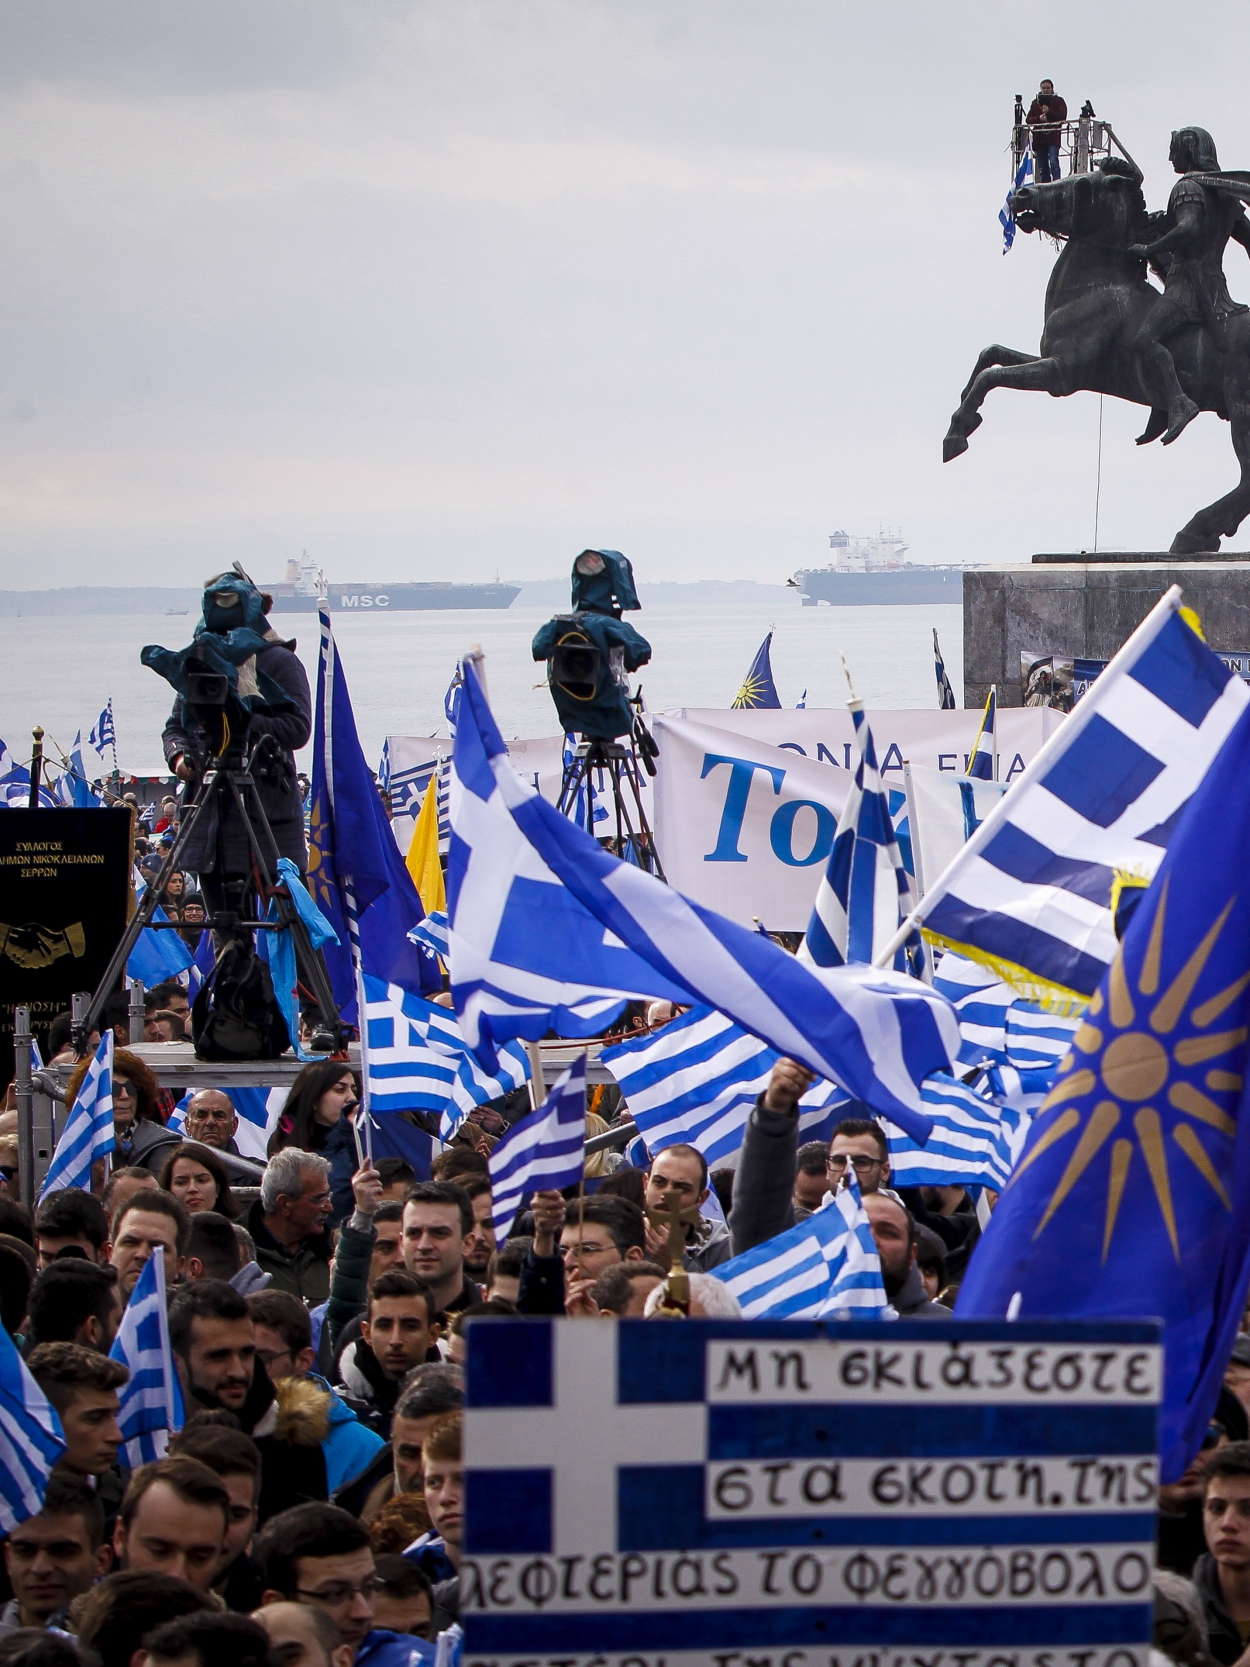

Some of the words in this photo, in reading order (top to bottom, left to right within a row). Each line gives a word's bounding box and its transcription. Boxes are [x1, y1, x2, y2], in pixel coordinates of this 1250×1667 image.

[341, 594, 390, 607] MSC
[15, 841, 64, 852] ΣΥΛΛΟΓΟΣ
[20, 867, 58, 877] ΣΕΡΡΩΝ
[719, 1348, 808, 1391] Μη
[713, 1462, 844, 1509] στα
[760, 1552, 825, 1597] το
